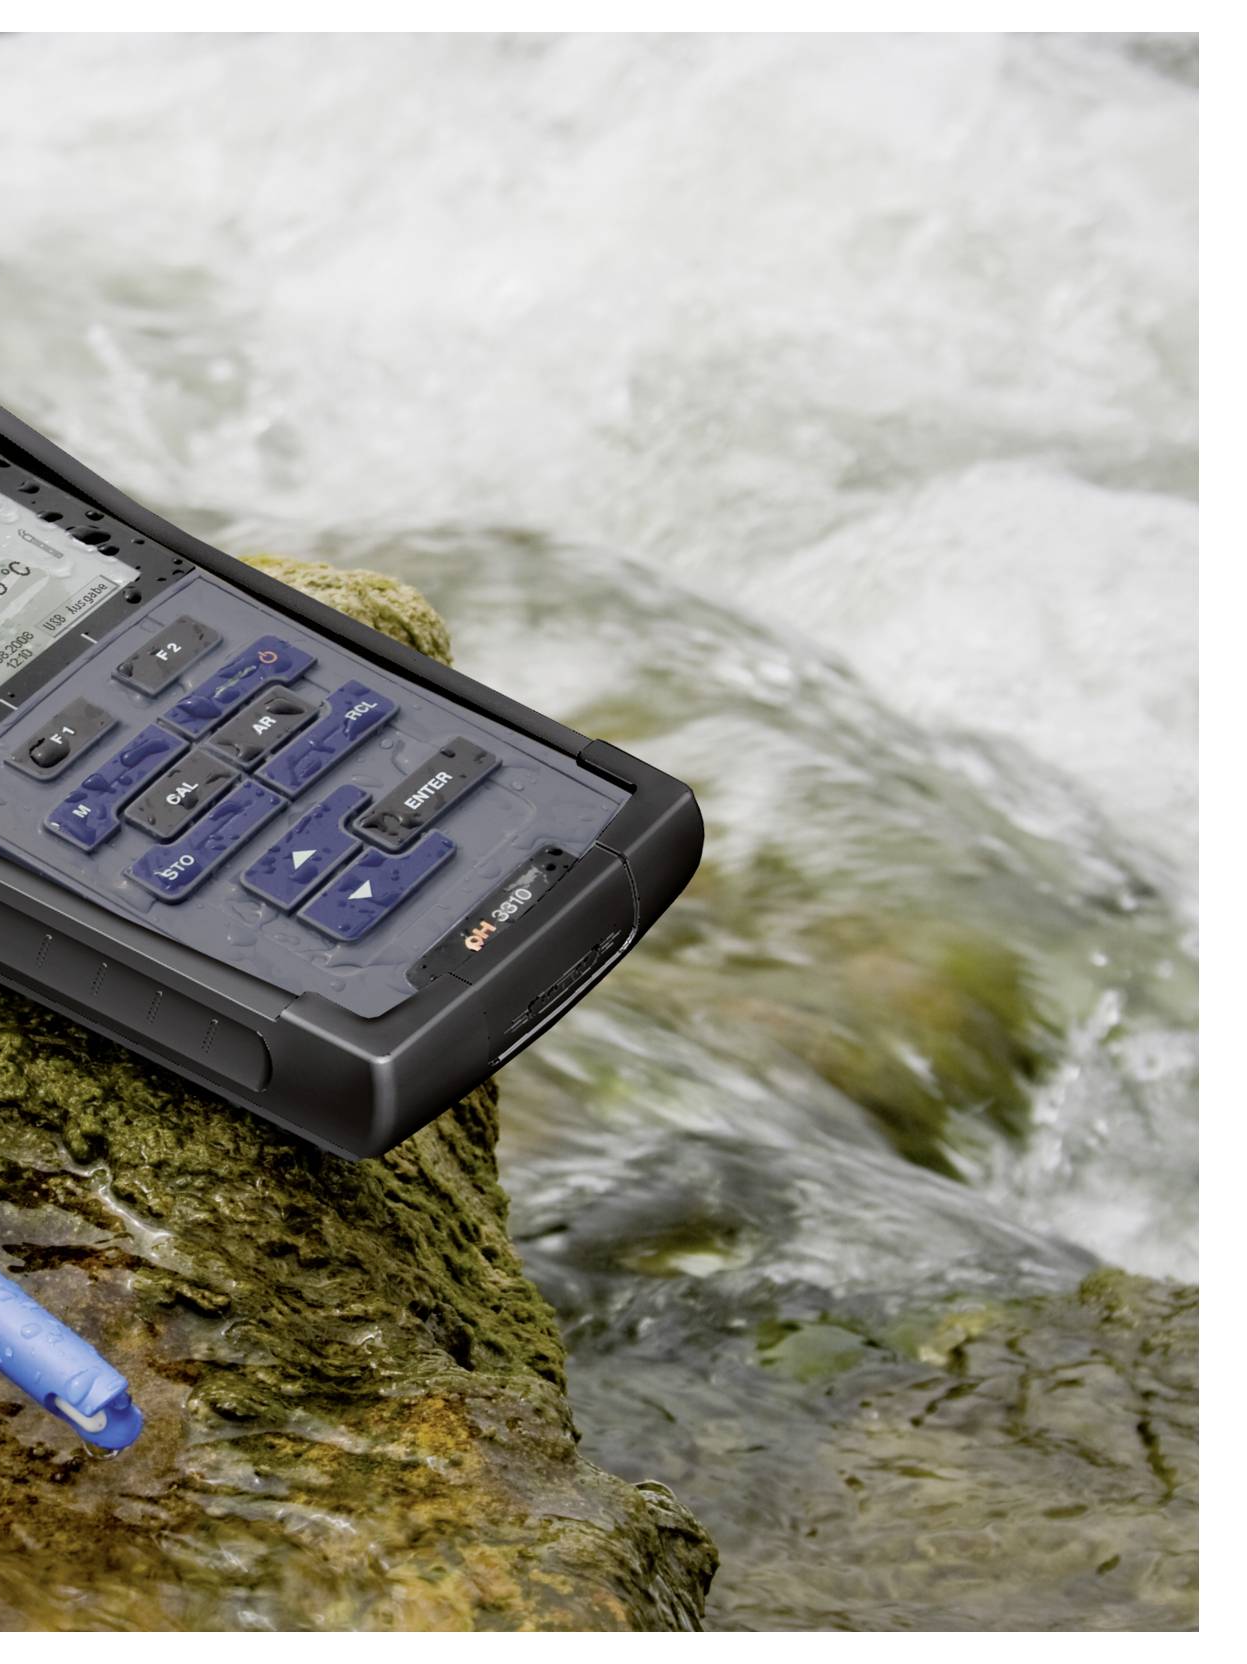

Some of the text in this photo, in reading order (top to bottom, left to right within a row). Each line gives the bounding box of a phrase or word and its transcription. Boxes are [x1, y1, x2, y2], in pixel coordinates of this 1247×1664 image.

[1, 561, 31, 577] °C
[42, 583, 108, 632] USB Ausgabe
[7, 648, 33, 670] 12:10
[344, 700, 379, 721] RCL
[252, 715, 277, 736] AR
[166, 781, 199, 806] CAL
[404, 771, 453, 810] ENTER
[72, 804, 91, 818] M
[161, 854, 195, 881] STO
[491, 888, 532, 922] 3310
